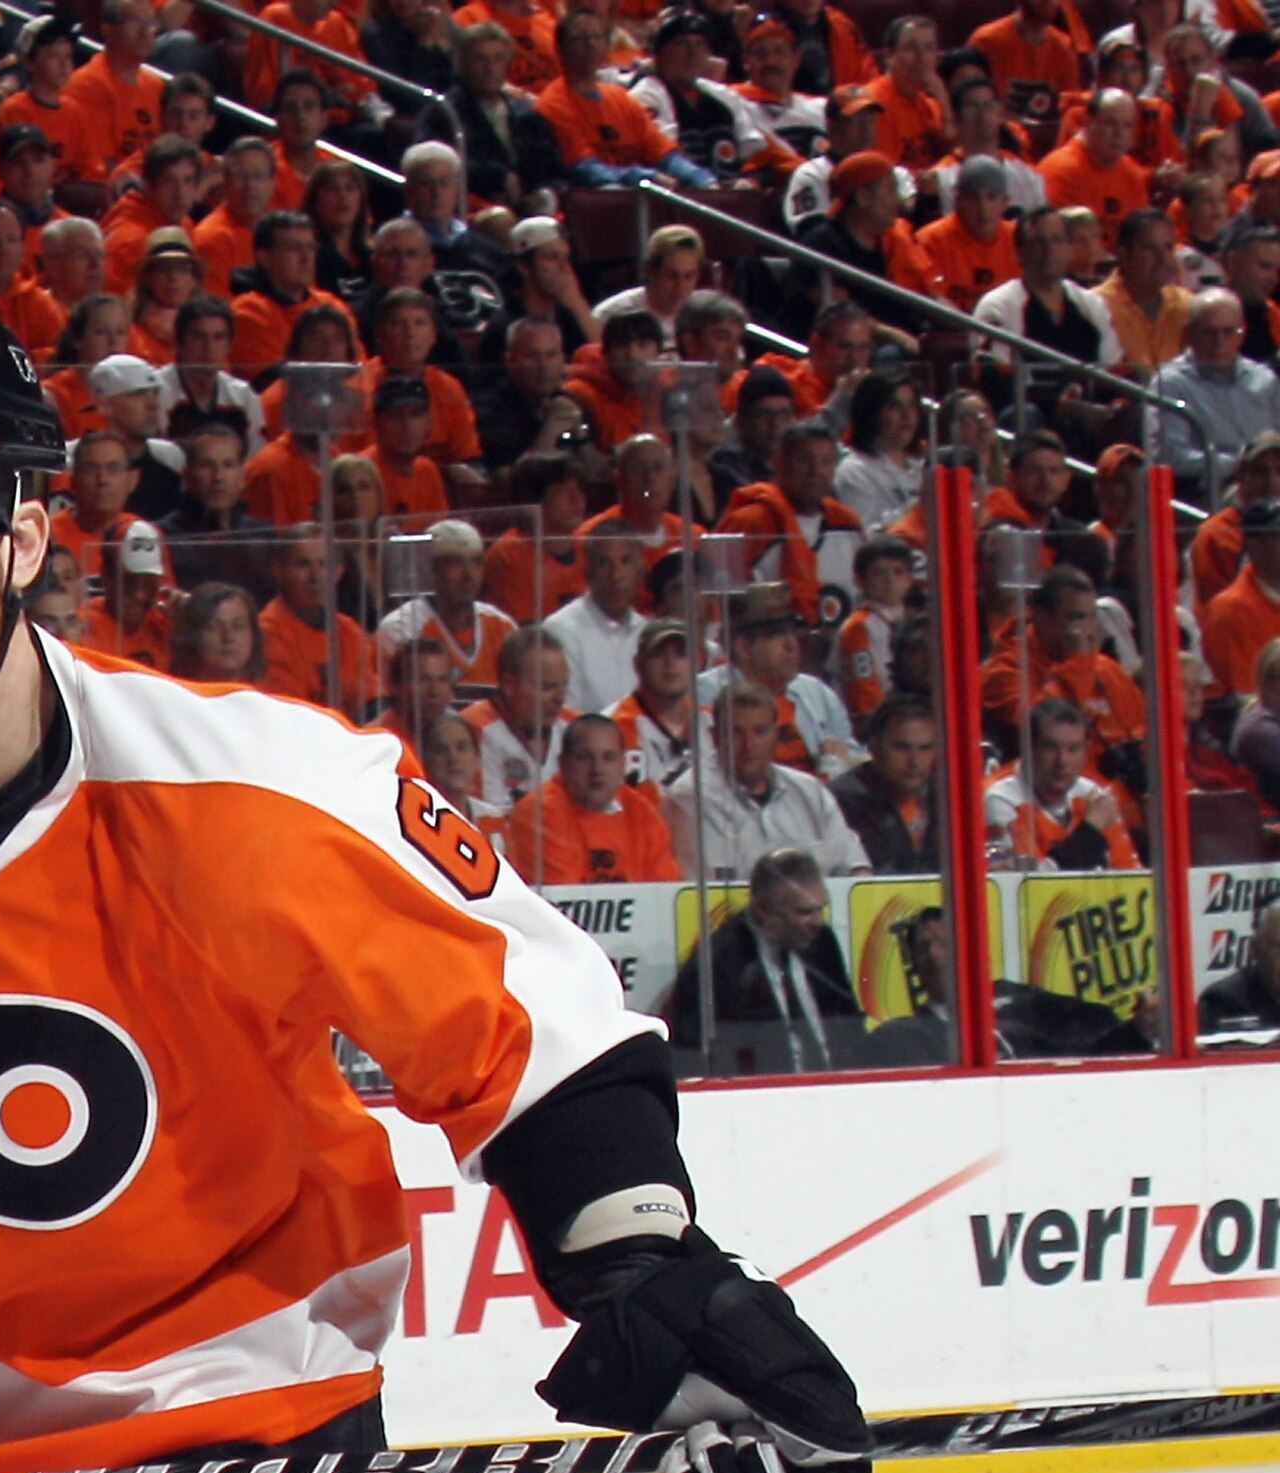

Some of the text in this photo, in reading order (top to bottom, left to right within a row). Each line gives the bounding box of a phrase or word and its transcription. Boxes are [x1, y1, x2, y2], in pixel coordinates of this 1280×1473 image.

[396, 778, 501, 902] 6
[1057, 888, 1150, 960] TIRES
[1071, 938, 1155, 999] PLUS
